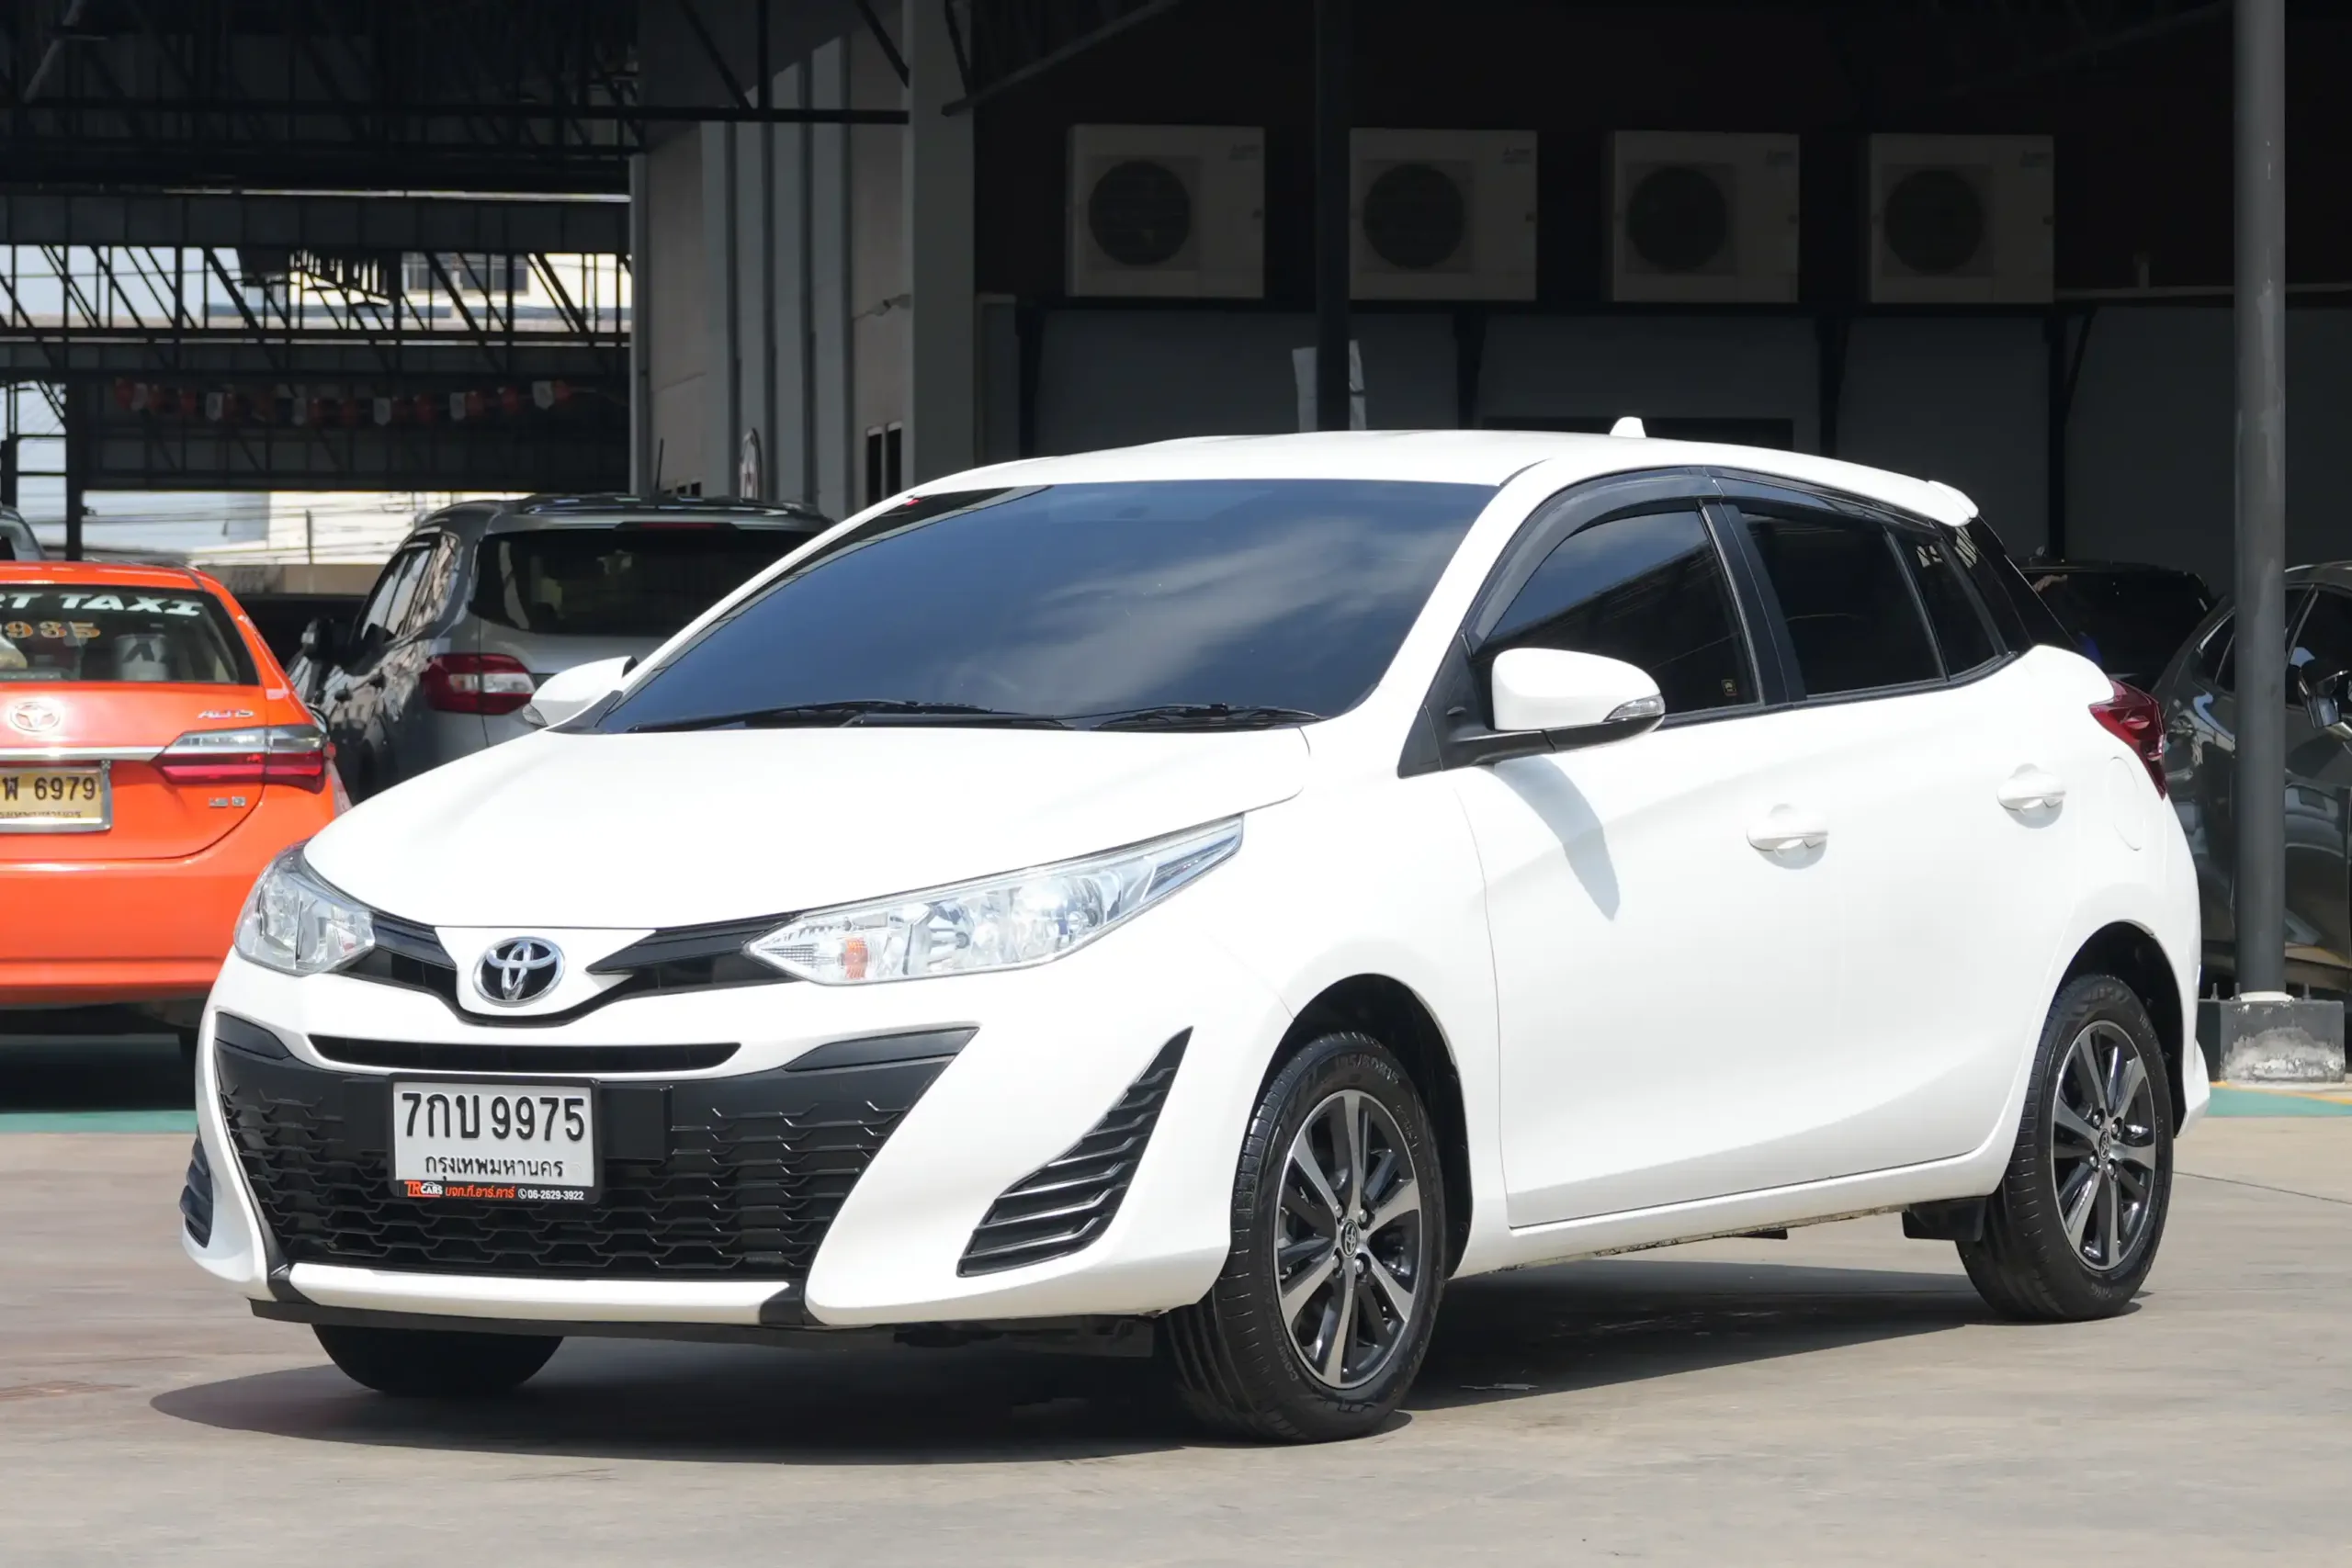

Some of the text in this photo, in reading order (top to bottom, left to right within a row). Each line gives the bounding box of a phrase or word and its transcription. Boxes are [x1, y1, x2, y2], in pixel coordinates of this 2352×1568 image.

[59, 593, 203, 616] TAXI
[34, 776, 96, 801] 6979
[491, 1096, 585, 1142] 9975
[425, 1156, 563, 1180] กรุงเทพมหานคร
